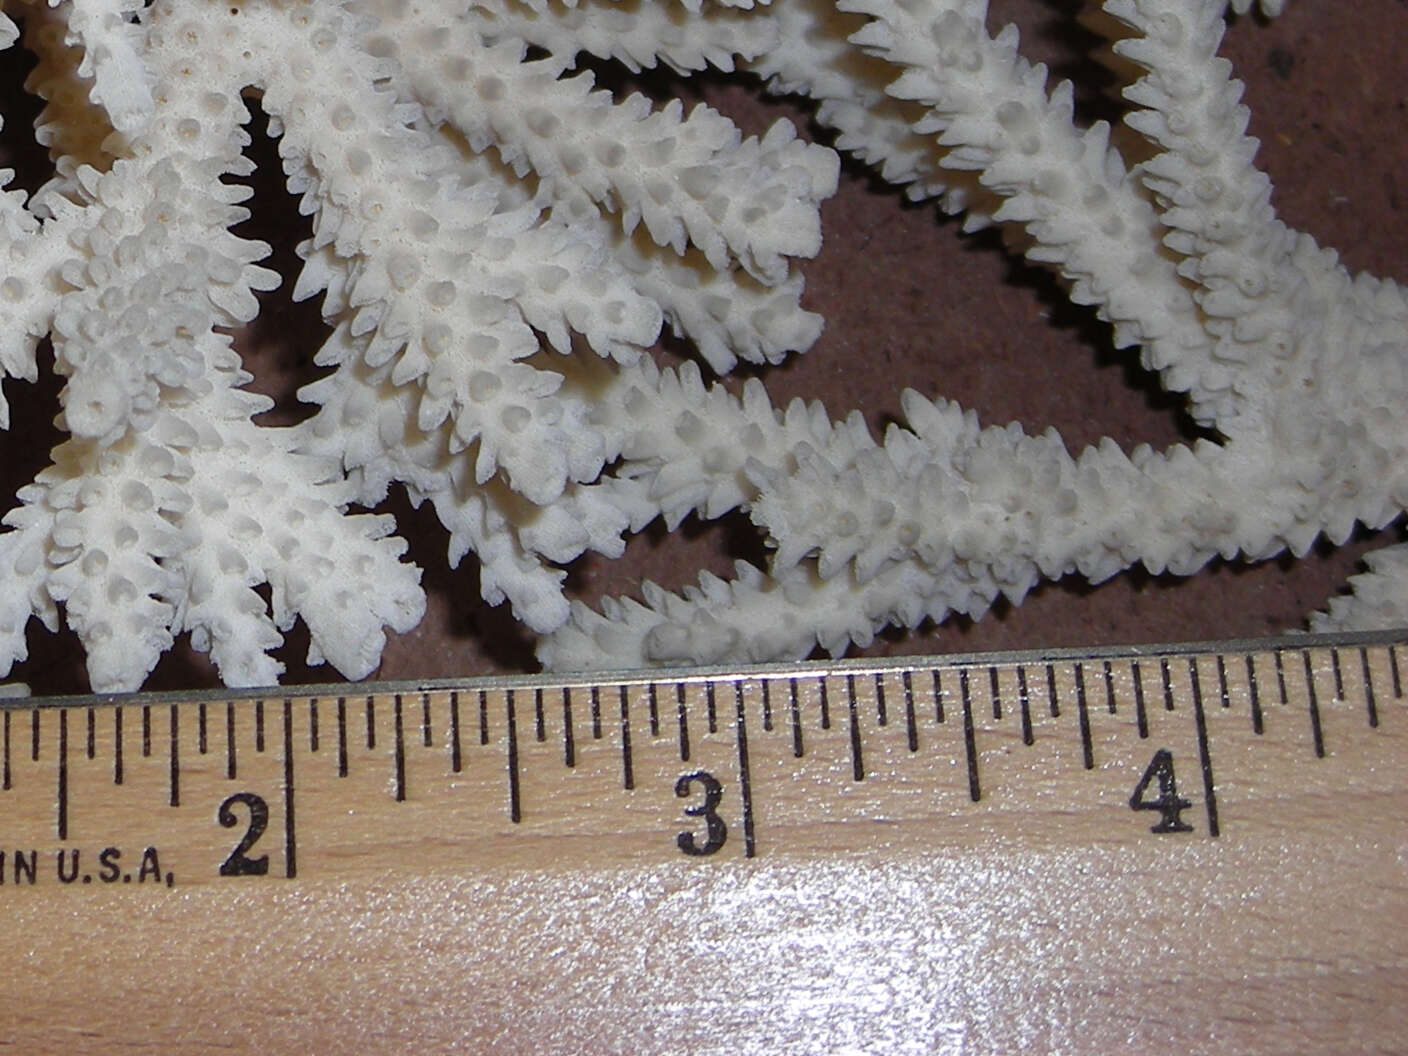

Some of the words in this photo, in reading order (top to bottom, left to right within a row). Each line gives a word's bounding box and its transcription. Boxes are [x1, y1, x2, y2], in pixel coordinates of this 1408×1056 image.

[217, 792, 270, 876] 2
[674, 769, 728, 857] 3
[1129, 748, 1194, 834] 4
